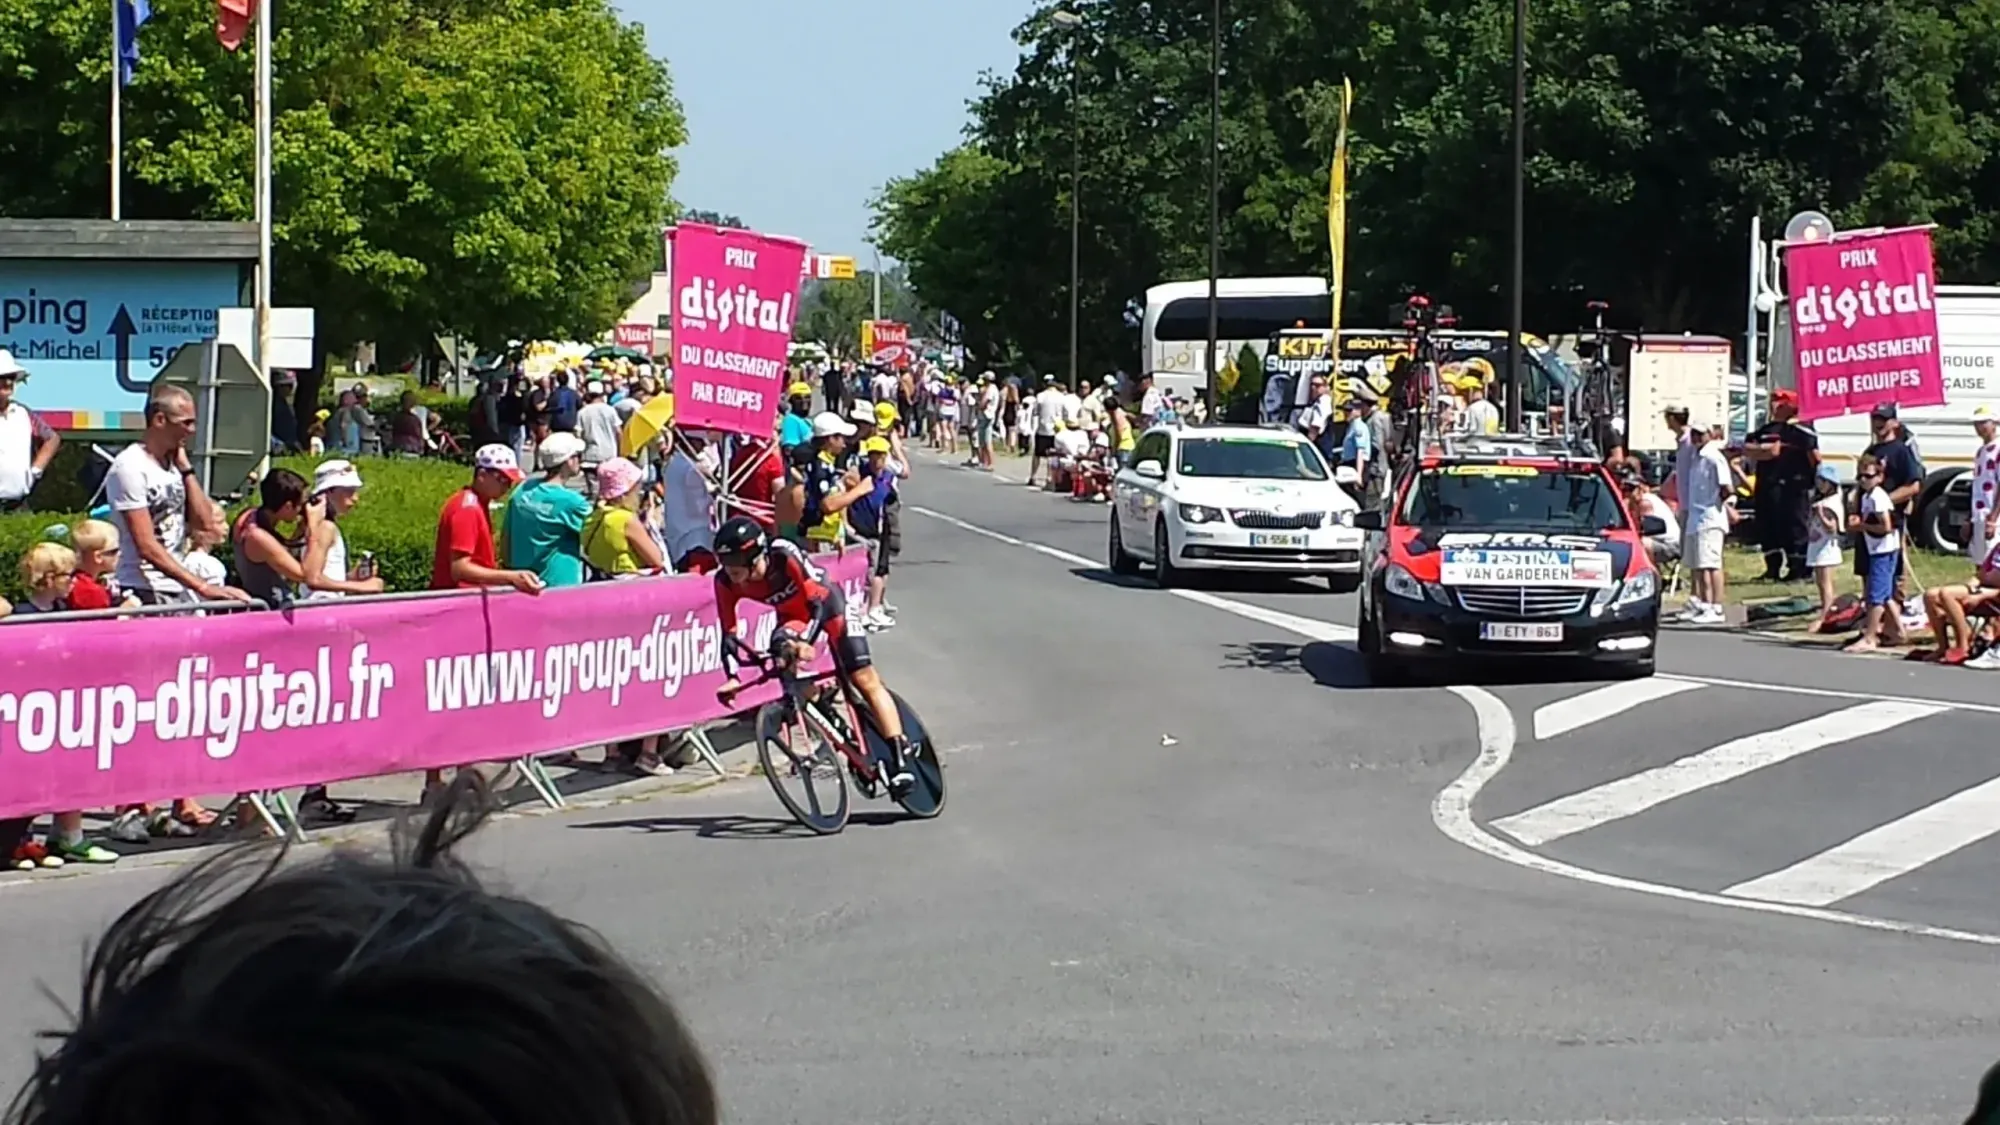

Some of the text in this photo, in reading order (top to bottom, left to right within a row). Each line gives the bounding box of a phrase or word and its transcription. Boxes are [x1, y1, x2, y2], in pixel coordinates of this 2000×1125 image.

[725, 246, 757, 270] PRIX
[1840, 248, 1877, 269] PRIX
[681, 275, 792, 334] digital
[1796, 272, 1932, 329] digital
[8, 339, 100, 359] t-Michel
[1280, 338, 1324, 355] KIT
[1800, 336, 1932, 368] DU CLASSEMENT
[681, 344, 781, 380] DU CLASSEMENT
[1266, 355, 1363, 375] Supporer
[1942, 356, 1994, 368] ROUGE
[691, 381, 713, 403] PAR
[1817, 369, 1920, 398] PAR EQUIPES
[1487, 551, 1562, 566] FESTINA
[1465, 568, 1569, 581] VAN GARDEREN
